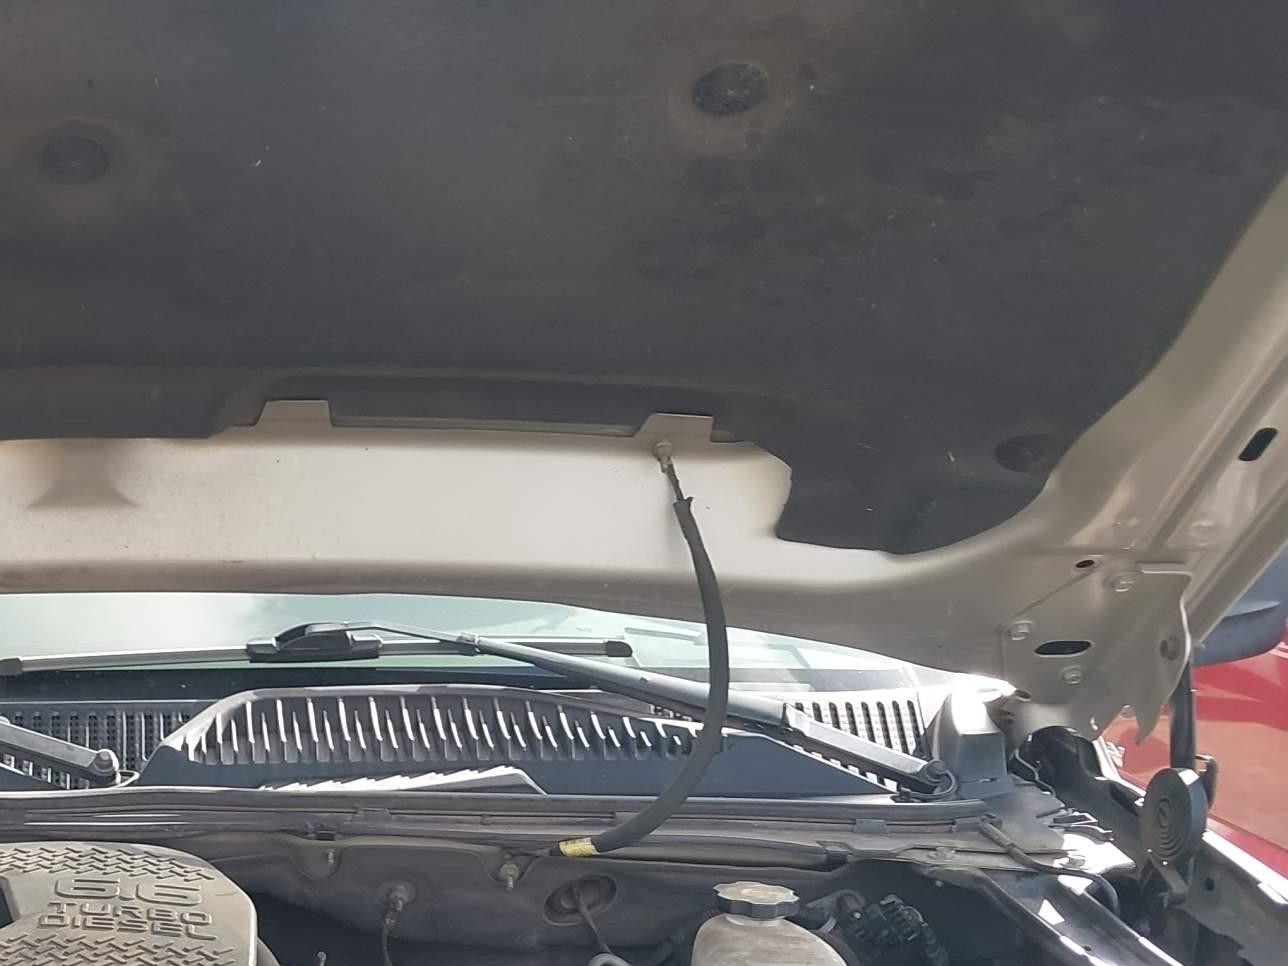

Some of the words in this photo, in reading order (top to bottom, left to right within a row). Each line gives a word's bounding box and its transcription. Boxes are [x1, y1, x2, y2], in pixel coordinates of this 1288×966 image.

[55, 878, 202, 906] 6.6
[38, 914, 217, 941] DIESEL
[48, 902, 212, 926] TURBO
